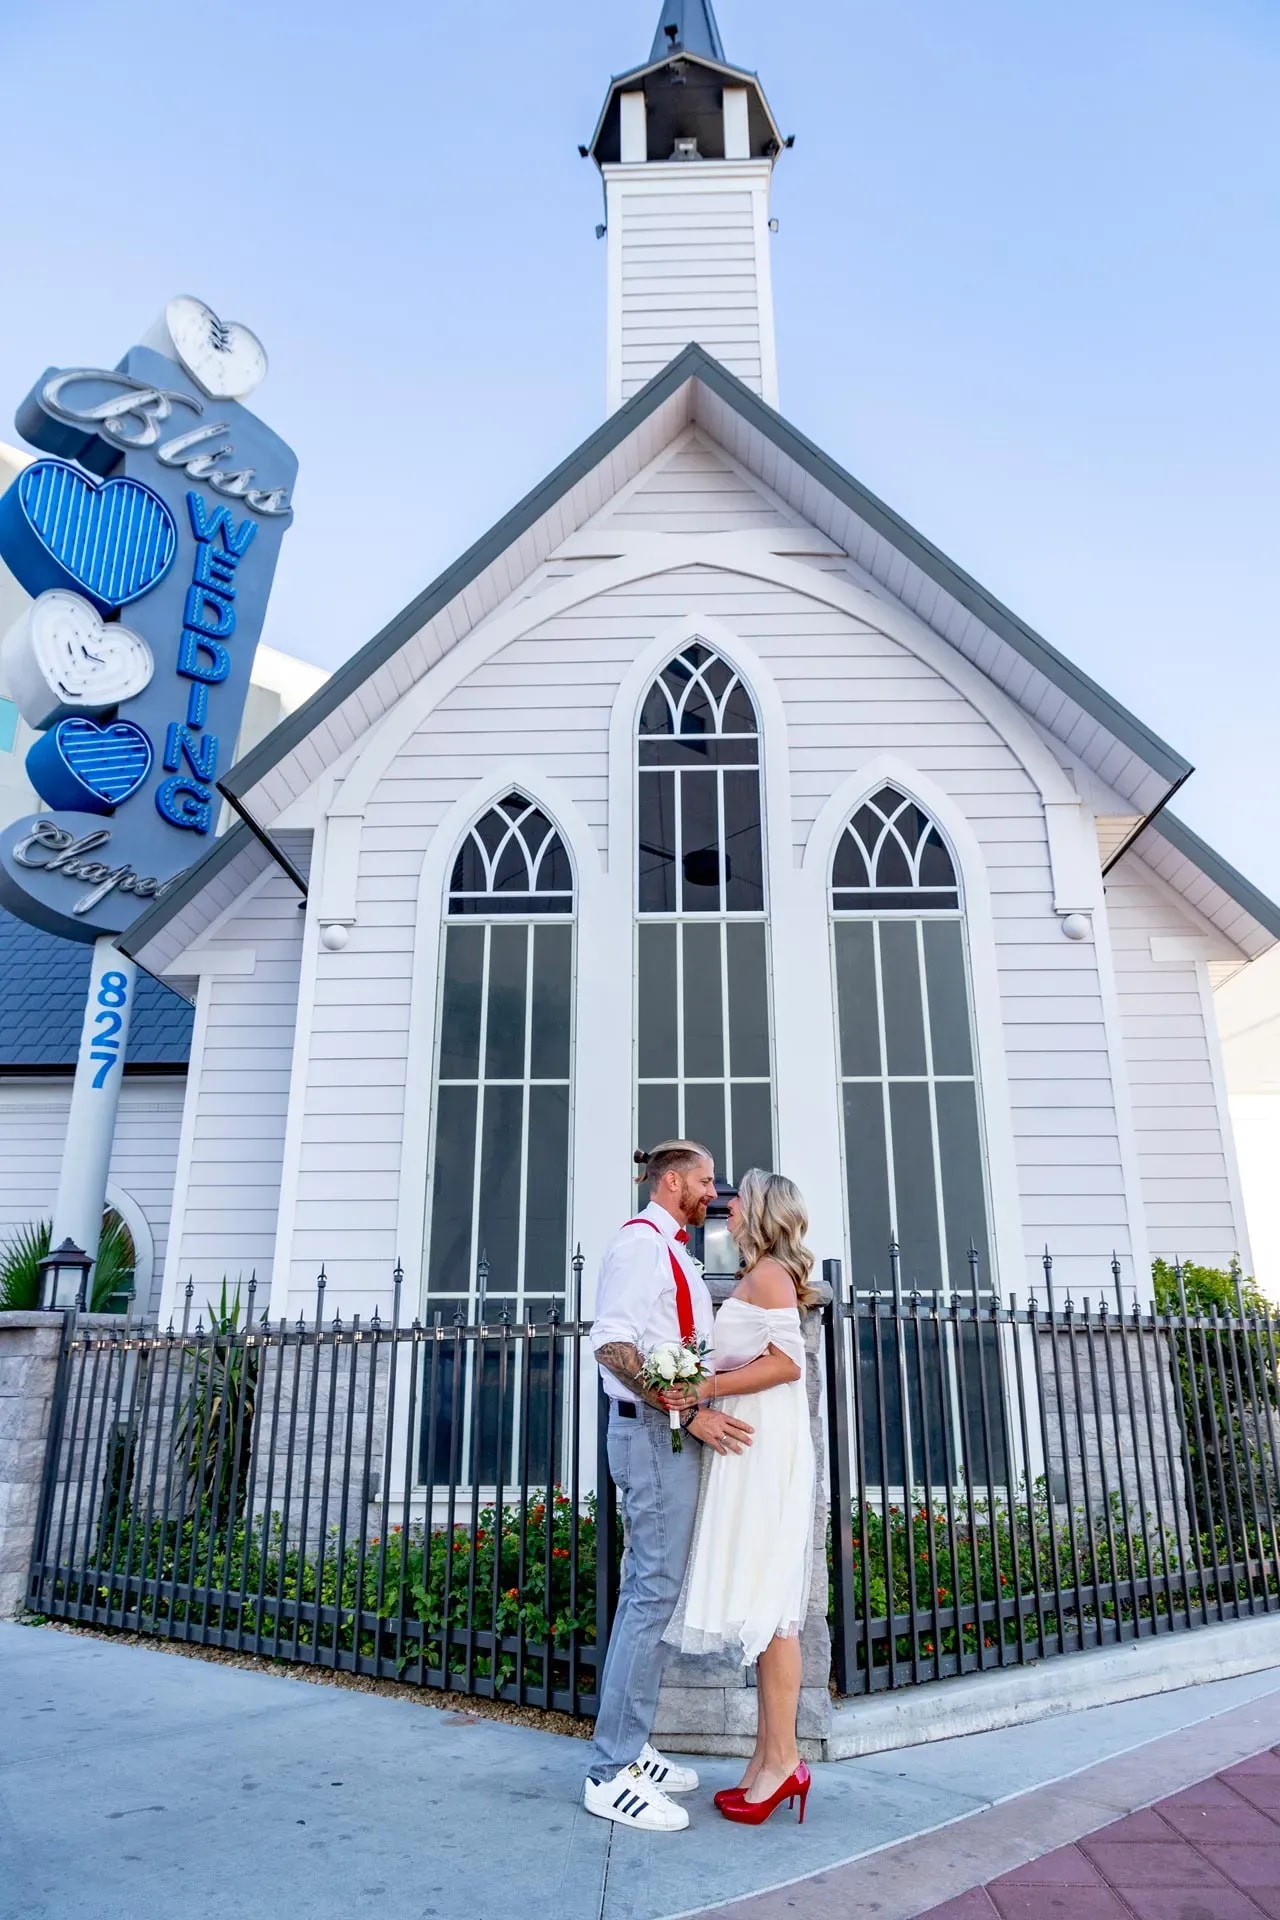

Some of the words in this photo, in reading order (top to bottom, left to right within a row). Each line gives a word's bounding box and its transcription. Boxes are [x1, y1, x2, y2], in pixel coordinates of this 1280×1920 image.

[41, 367, 292, 515] Bliss
[155, 490, 259, 834] WEDDING
[91, 971, 128, 1089] 827
